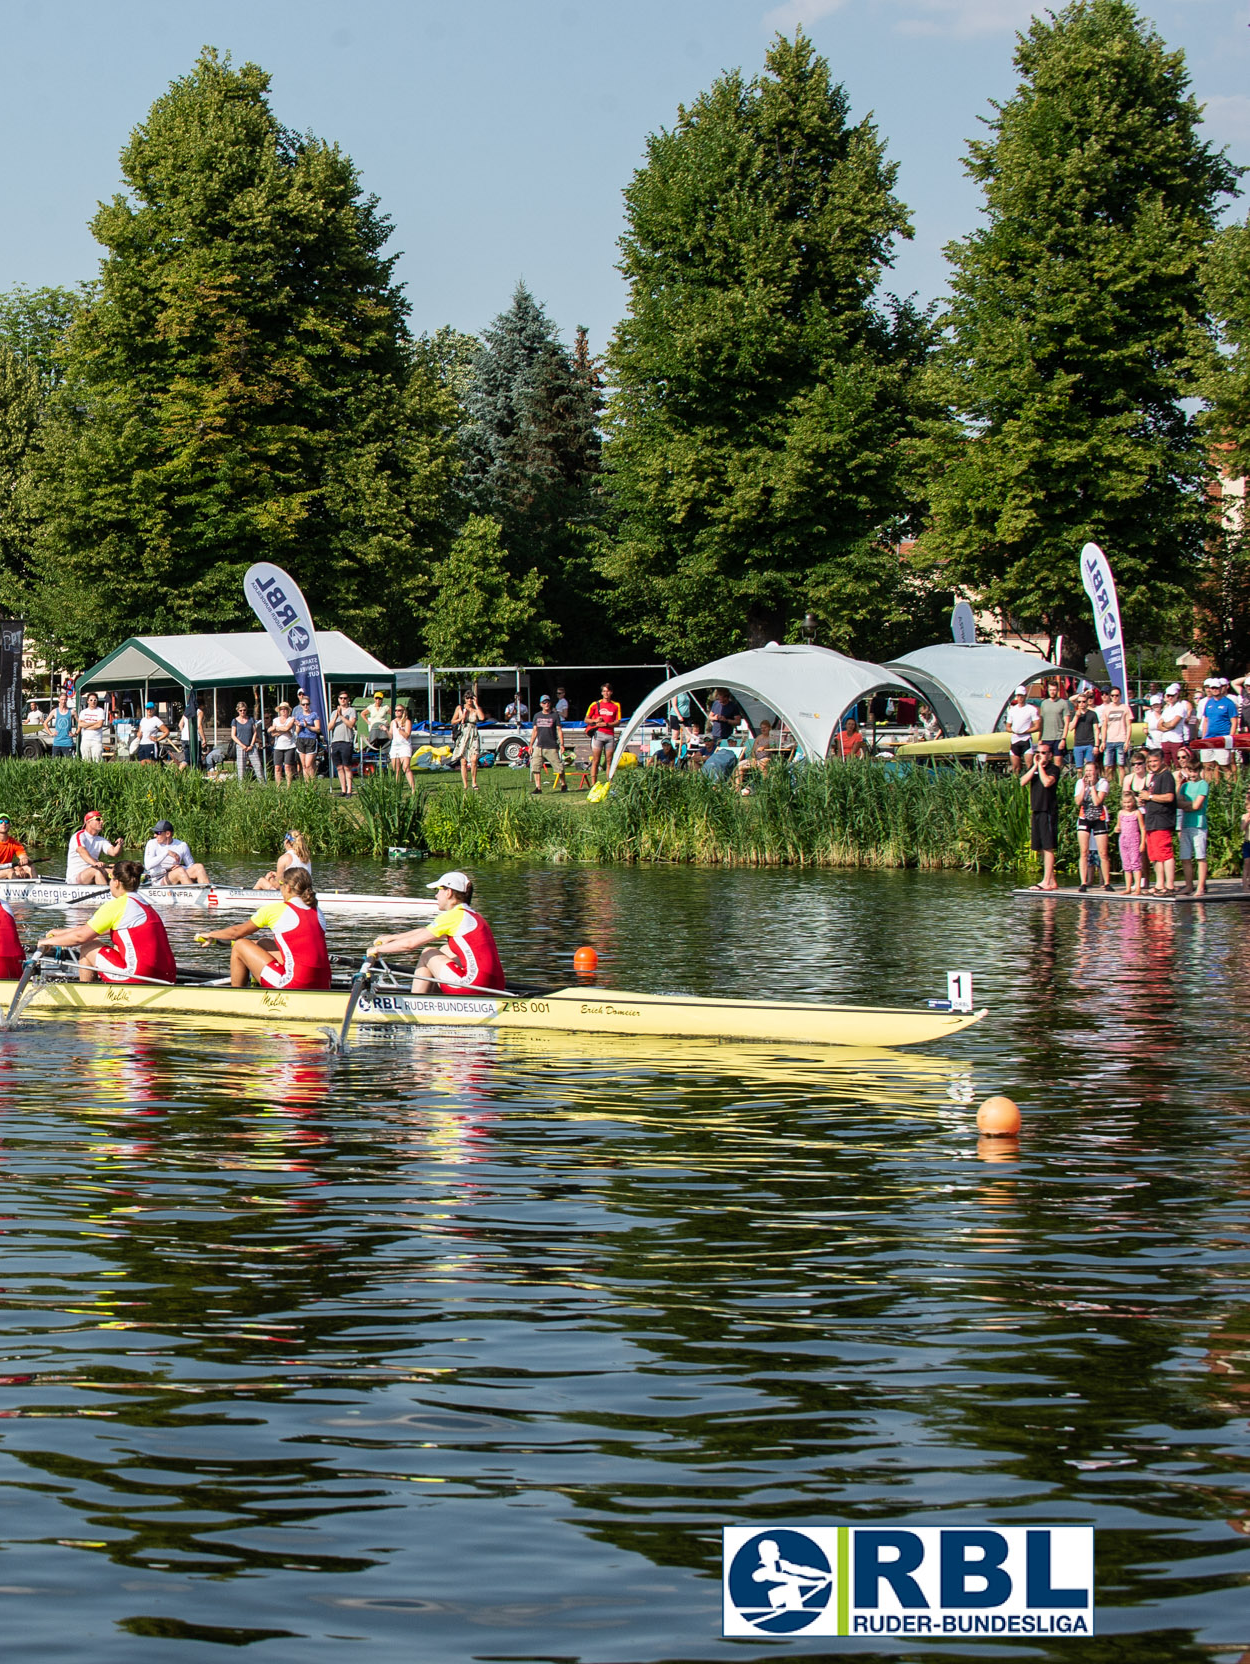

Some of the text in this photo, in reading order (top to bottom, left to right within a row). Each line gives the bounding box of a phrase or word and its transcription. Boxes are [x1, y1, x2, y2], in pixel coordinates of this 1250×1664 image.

[952, 975, 962, 998] 1
[373, 997, 496, 1013] RBL RUDER-BUNDESLIGA
[502, 1001, 550, 1013] Z BS 001
[580, 1004, 641, 1017] Erich Domeier
